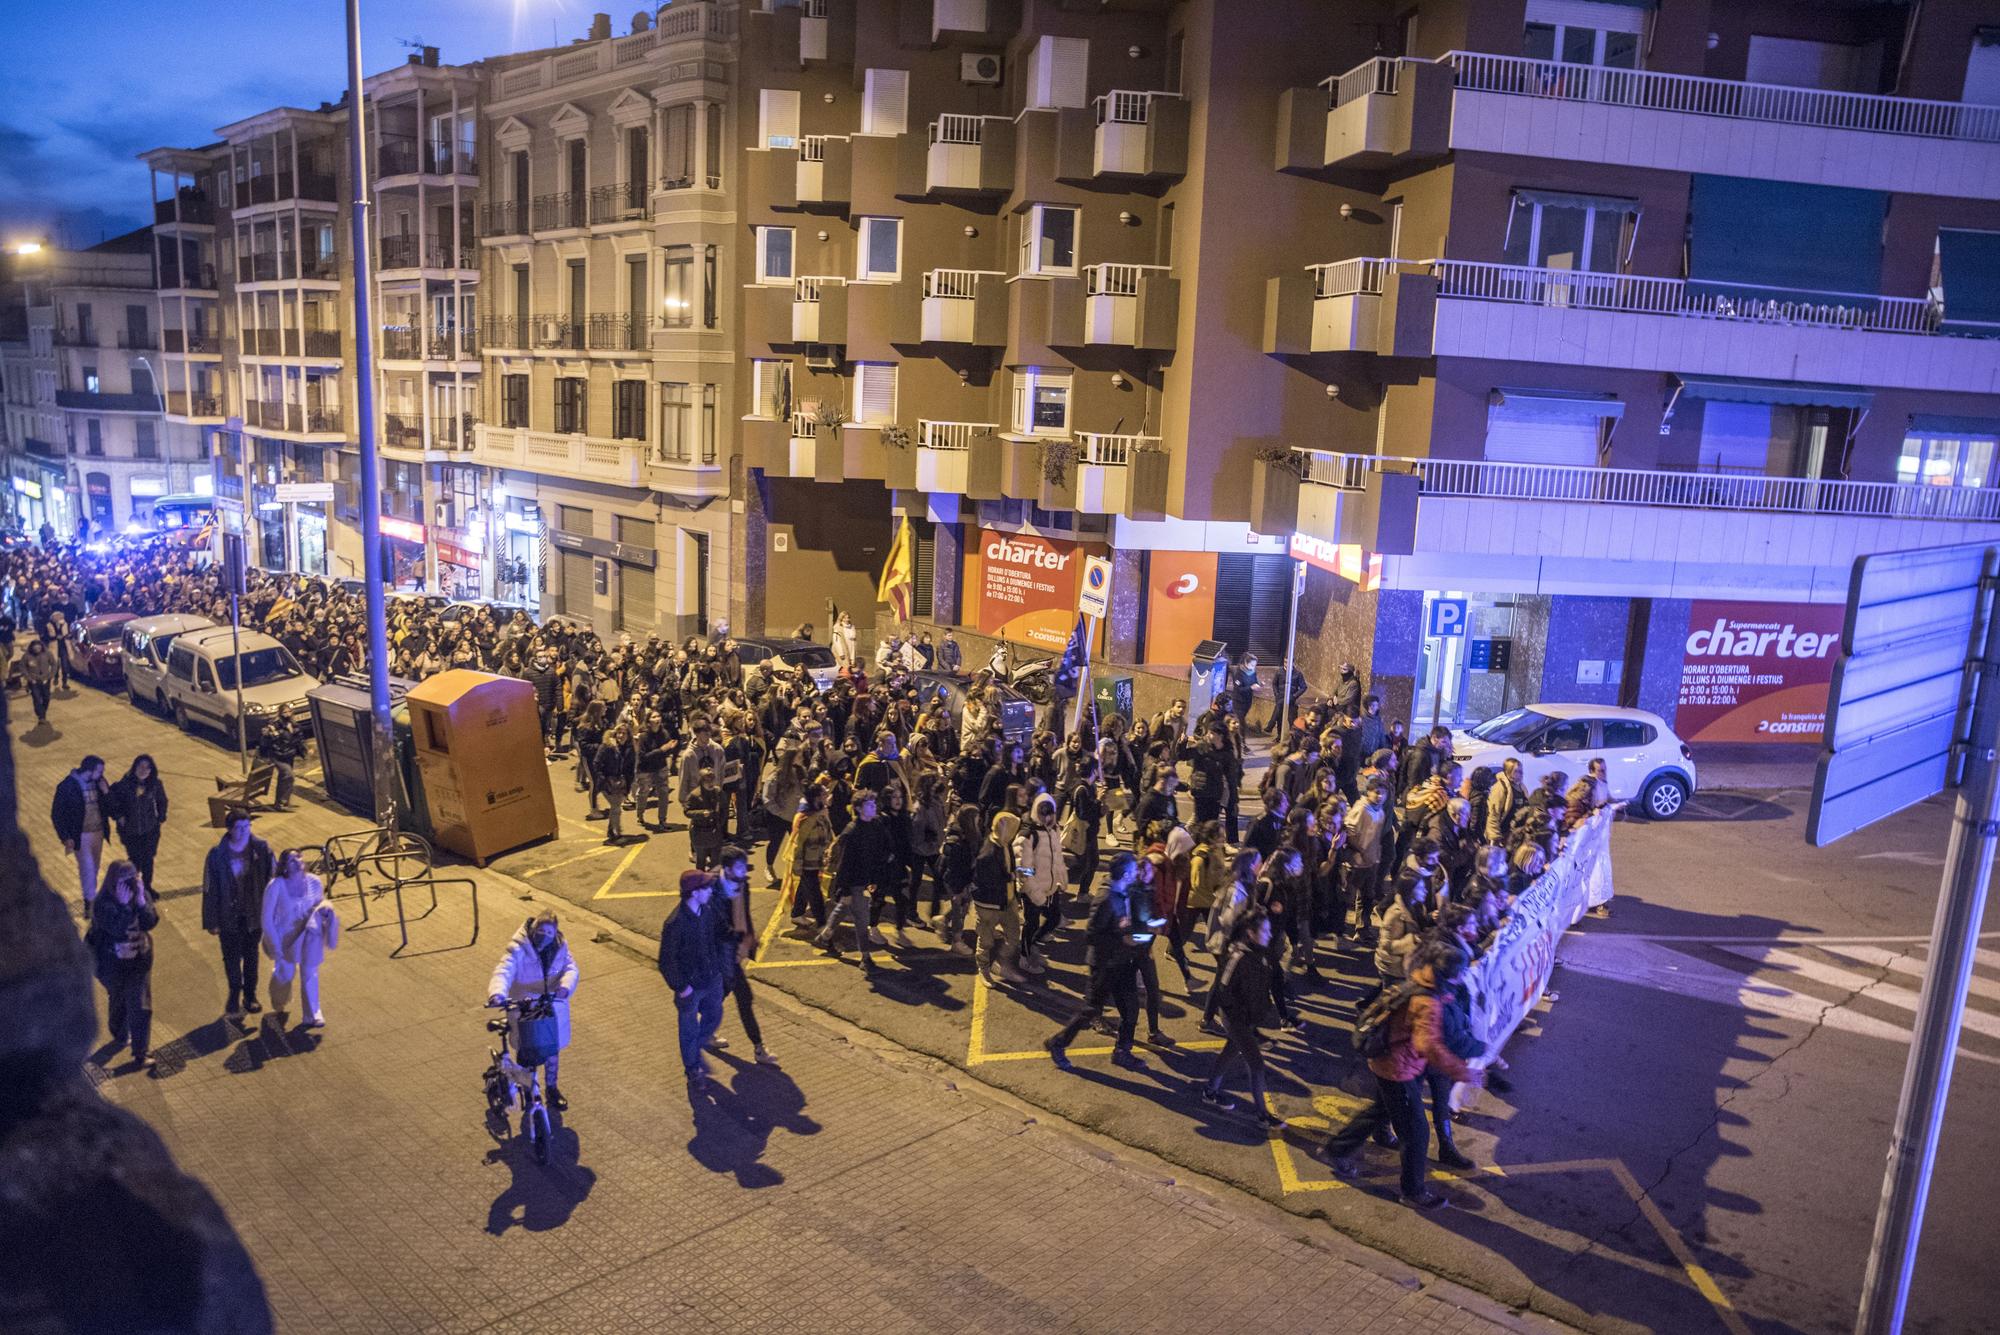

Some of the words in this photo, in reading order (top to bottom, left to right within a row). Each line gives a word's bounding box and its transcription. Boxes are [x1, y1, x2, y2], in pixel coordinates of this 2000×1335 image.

[987, 538, 1070, 570] charter
[987, 575, 1006, 585] DILLUNS
[1036, 582, 1055, 593] FESTIUS
[1436, 603, 1460, 634] P
[1729, 620, 1781, 630] Supermercats
[1033, 632, 1067, 644] consum
[1686, 618, 1839, 659] charter
[1683, 664, 1708, 674] HORARI
[1709, 664, 1750, 674] D'OBERTURA
[1682, 675, 1710, 684] DILLUNS
[1711, 675, 1716, 684] A
[1717, 675, 1751, 685] DIUMENGE
[1756, 675, 1783, 685] FESTIUS
[1680, 685, 1688, 694] de
[1689, 685, 1705, 694] 9:00
[1711, 685, 1729, 694] 15:00
[1729, 685, 1735, 694] h.
[1679, 695, 1687, 704] de
[1688, 695, 1706, 704] 17:00
[1712, 695, 1731, 705] 22:00
[1731, 695, 1738, 705] h.
[1781, 712, 1787, 720] la
[1769, 721, 1825, 733] consum
